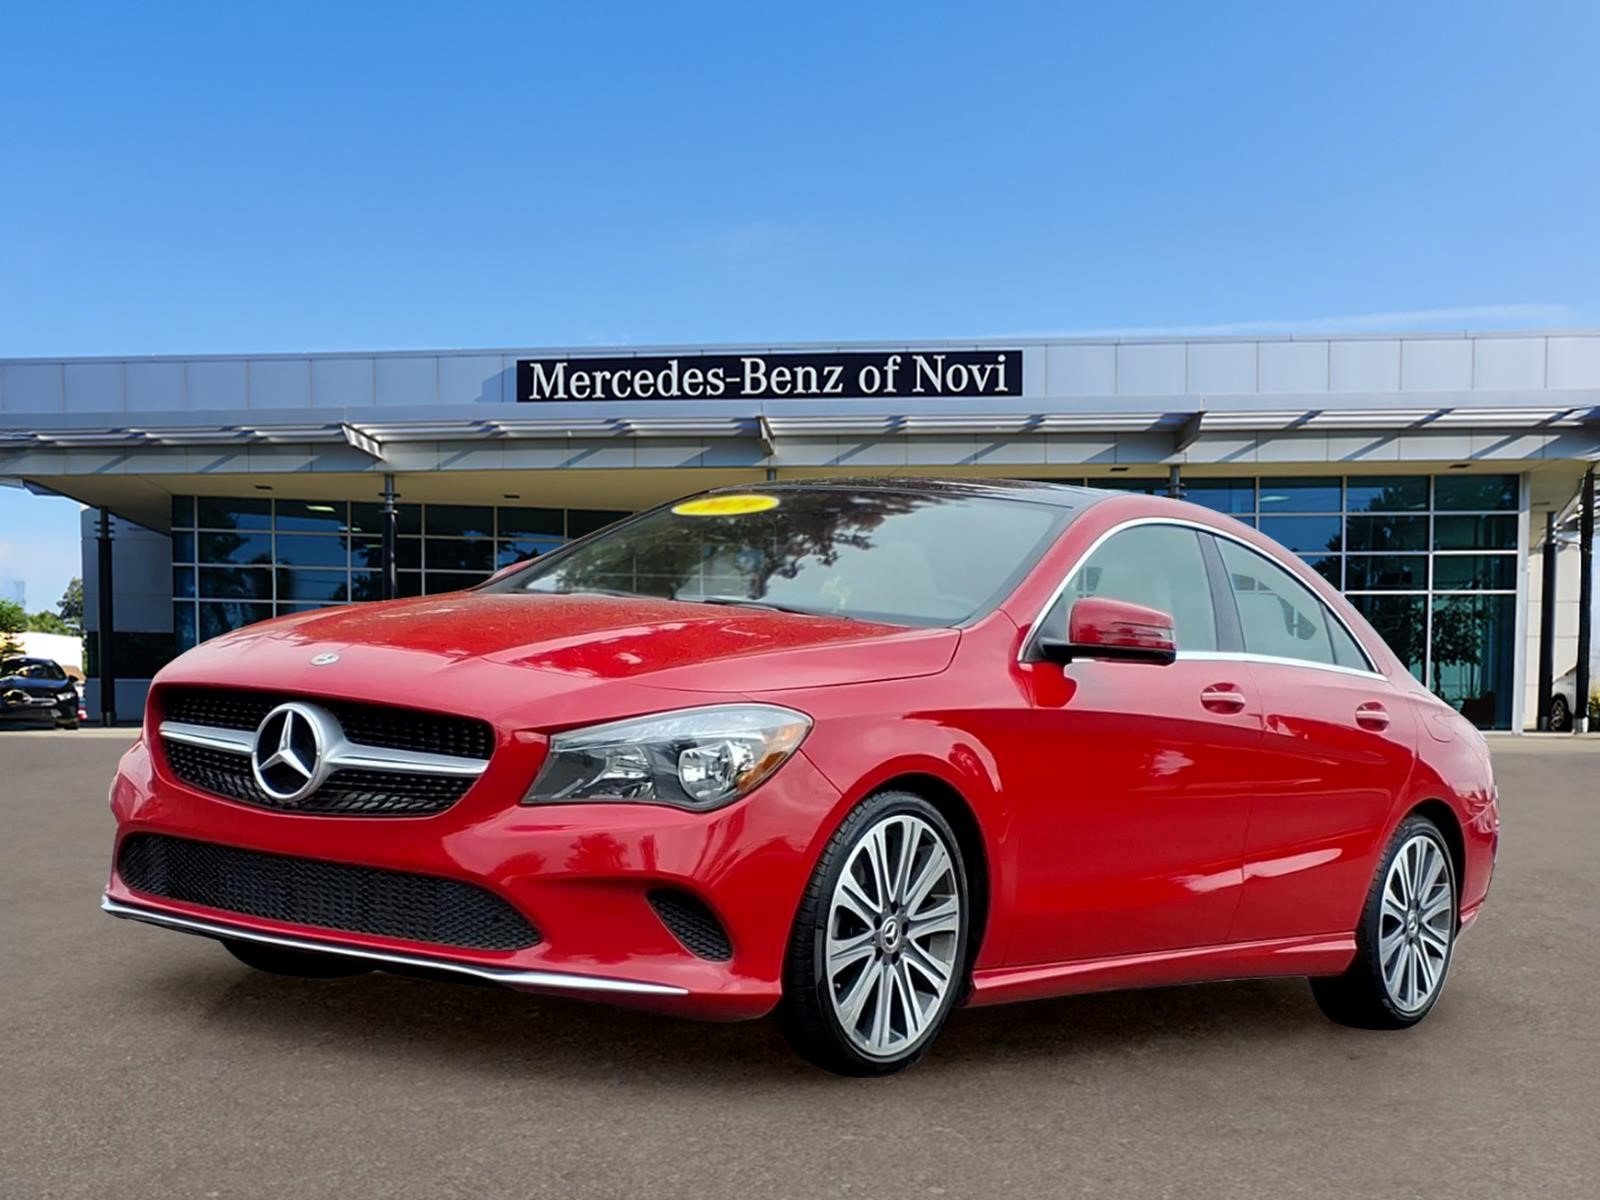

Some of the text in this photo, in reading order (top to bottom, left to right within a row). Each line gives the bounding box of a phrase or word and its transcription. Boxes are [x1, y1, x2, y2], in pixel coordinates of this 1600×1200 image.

[529, 354, 1009, 400] Mercedes-Benz of Novi
